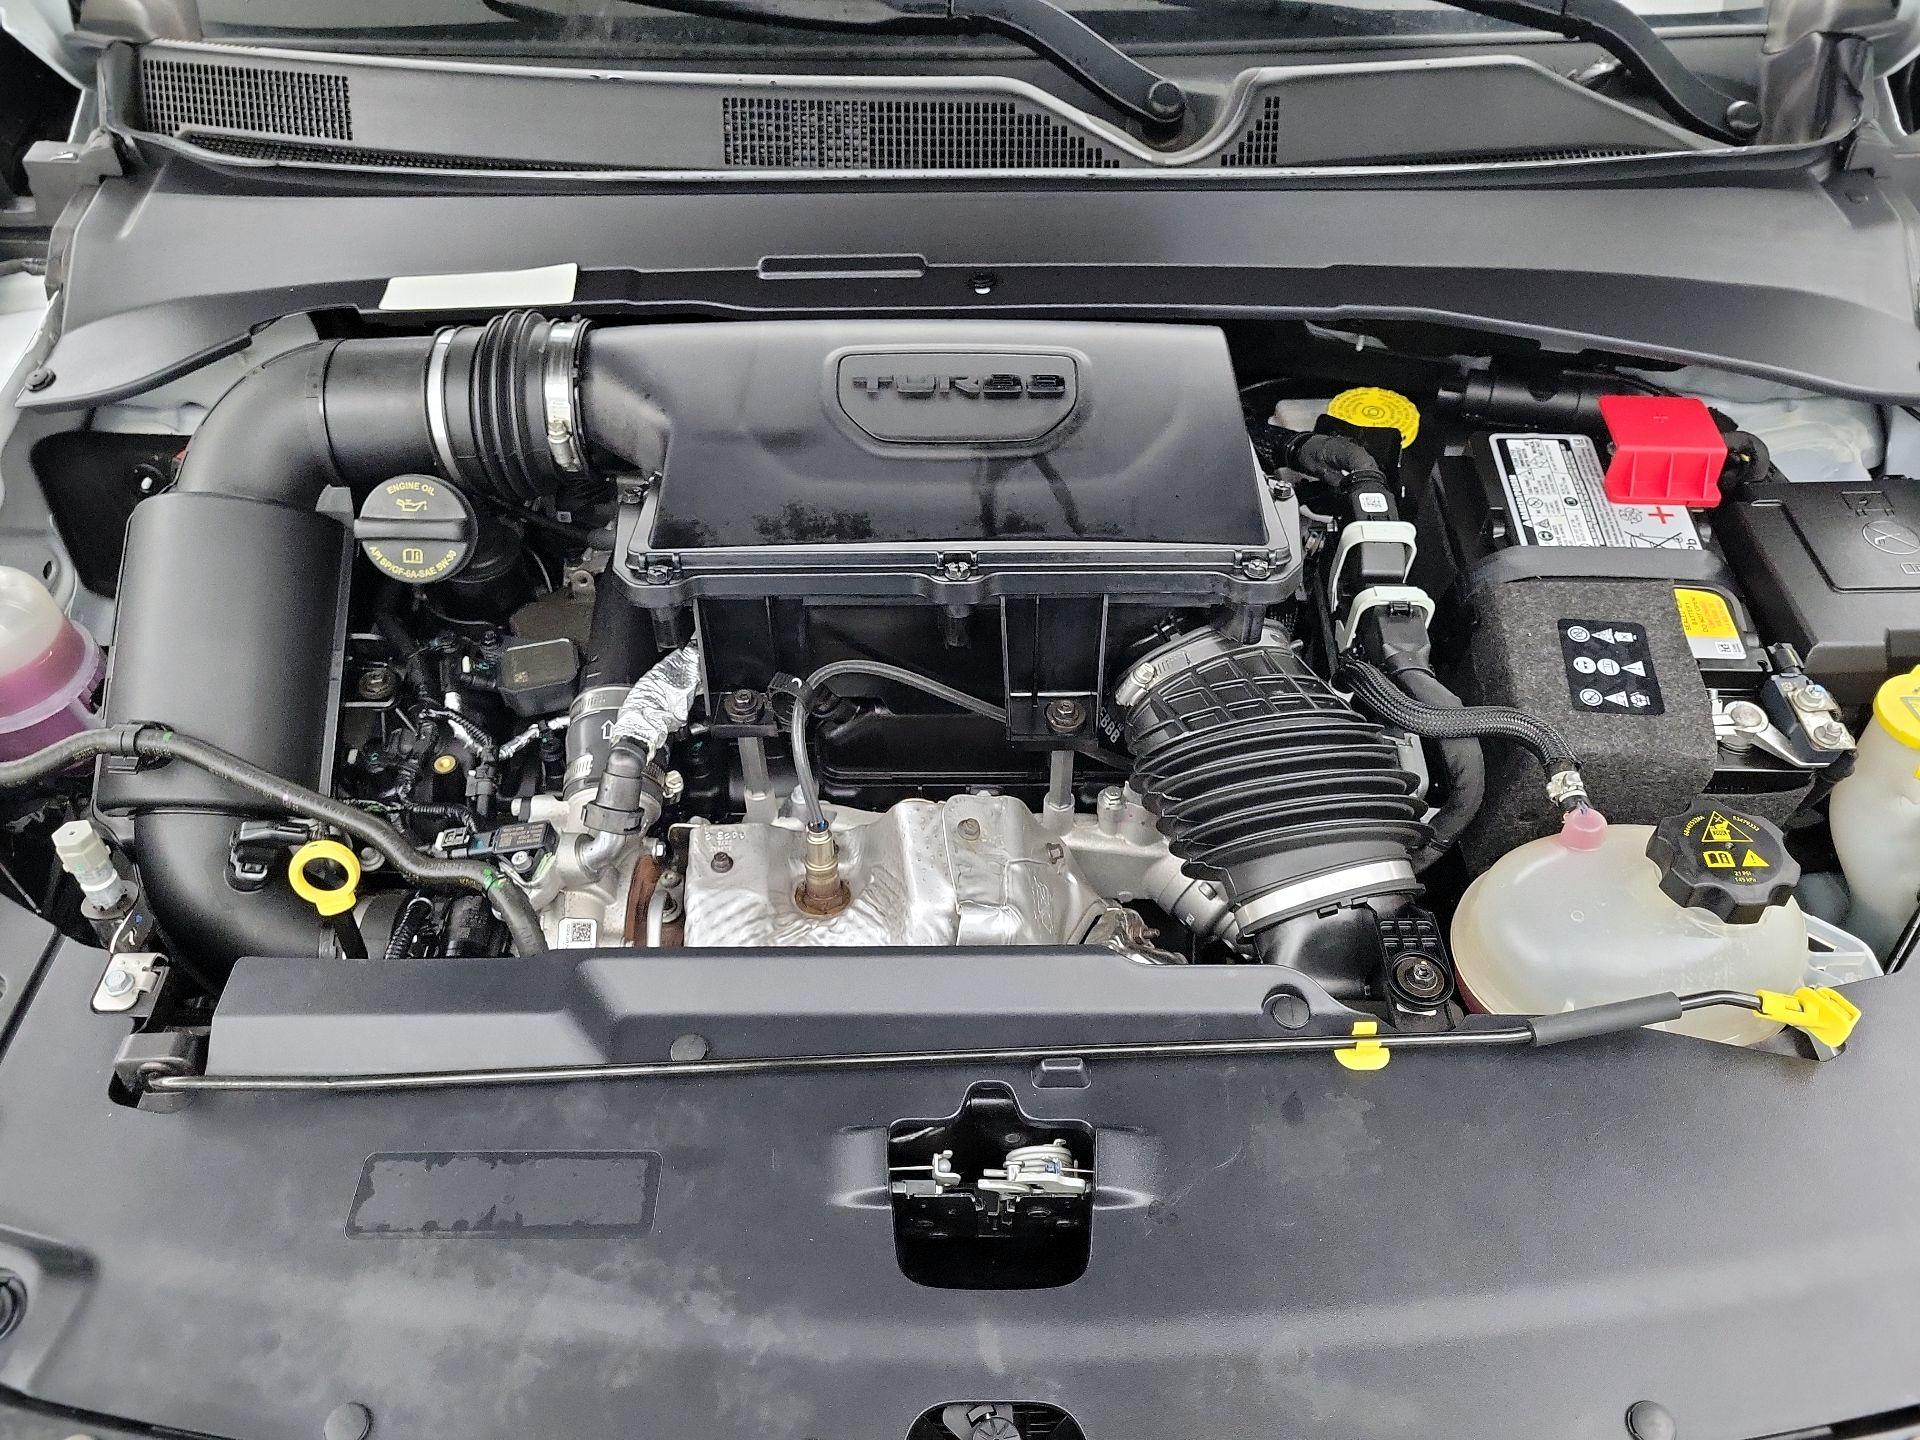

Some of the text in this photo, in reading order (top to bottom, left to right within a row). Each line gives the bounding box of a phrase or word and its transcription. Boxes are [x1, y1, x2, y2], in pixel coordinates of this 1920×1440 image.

[851, 374, 1066, 400] TURBO
[386, 482, 435, 496] ENGINE OIL
[369, 546, 383, 561] API
